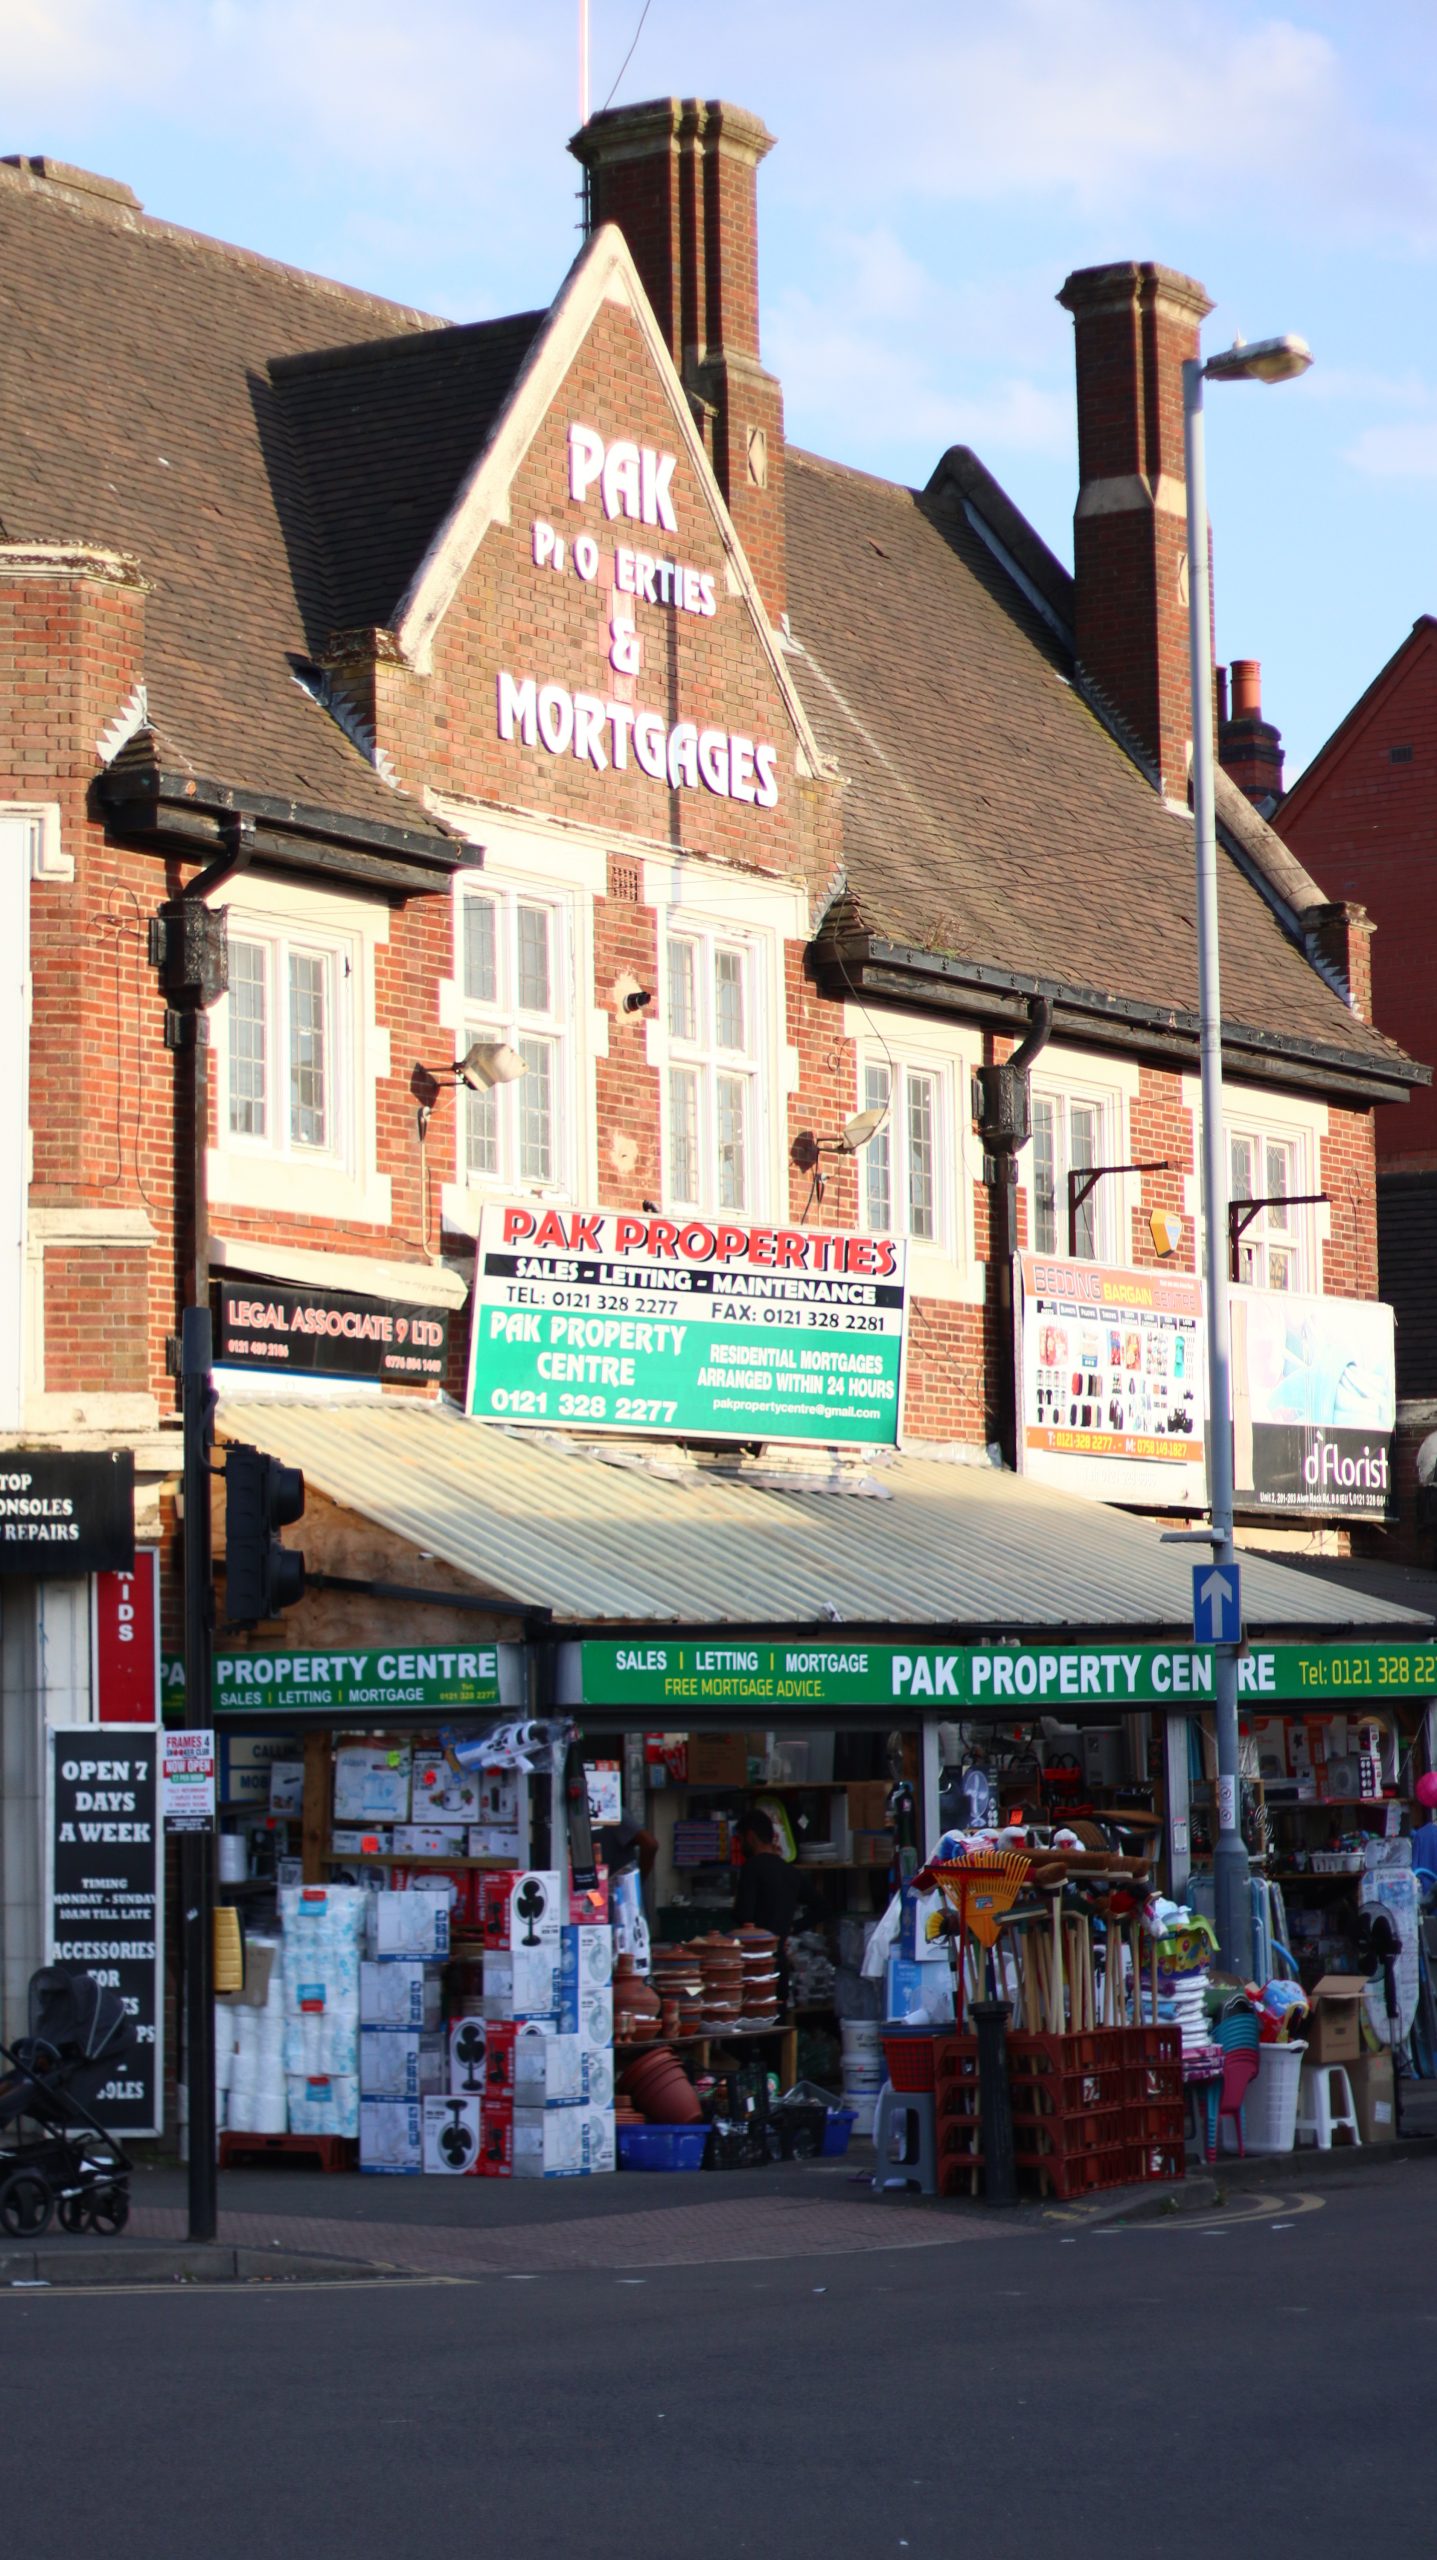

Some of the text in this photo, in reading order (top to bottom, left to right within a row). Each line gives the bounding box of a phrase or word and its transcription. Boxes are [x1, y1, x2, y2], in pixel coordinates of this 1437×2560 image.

[568, 423, 678, 533] PAK
[609, 617, 640, 676] &
[497, 671, 779, 808] MORTGAGES
[503, 1208, 896, 1277] PAK PROPERTIES
[516, 1258, 579, 1281] SALES
[600, 1266, 691, 1291] LETTING
[713, 1273, 877, 1305] MAINTENANCE
[1033, 1266, 1101, 1300] BEDDING
[1103, 1283, 1153, 1306] BARGAIN
[506, 1286, 678, 1316] TEL: 0121 328 2277
[229, 1300, 289, 1331] LEGAL
[291, 1307, 393, 1341] ASSOCIATE
[412, 1320, 443, 1347] LTD
[711, 1302, 884, 1331] FAX: 0121 328 2281
[490, 1313, 687, 1356] PAK PROPERTY
[537, 1352, 636, 1387] CENTRE
[710, 1344, 884, 1375] RESIDENTIAL MORTGAGES
[698, 1367, 894, 1400] ARRANGED WITHIN 24 HOURS
[491, 1388, 678, 1423] 0121 328 2277
[713, 1398, 880, 1420] pakpropertycentre@gmail.com
[1125, 1438, 1136, 1453] M:
[5, 1523, 79, 1541] REPAIRS
[216, 1656, 368, 1685] PROPERTY
[377, 1652, 496, 1681] CENTRE
[616, 1650, 869, 1673] SALES LETTING MORTGAGE
[892, 1654, 1437, 1696] PAK PROPERTY CENRE Tel: 0121 328 22
[220, 1688, 424, 1706] SALES LETTING MORTGAGE
[664, 1678, 825, 1697] FREE MORTGAGE ADVICE.
[166, 1736, 210, 1748] FRAMES 4
[62, 1761, 148, 1781] OPEN 7
[166, 1760, 210, 1772] NOW OPEN
[75, 1792, 135, 1812] DAYS
[59, 1822, 150, 1843] A WEEK
[81, 1878, 128, 1889] TIMING
[53, 1893, 103, 1904] MONDAY
[112, 1893, 156, 1904] SUNDAY
[60, 1909, 151, 1920] 10AM TILL LATE
[52, 1941, 155, 1960] ACCESSORIES
